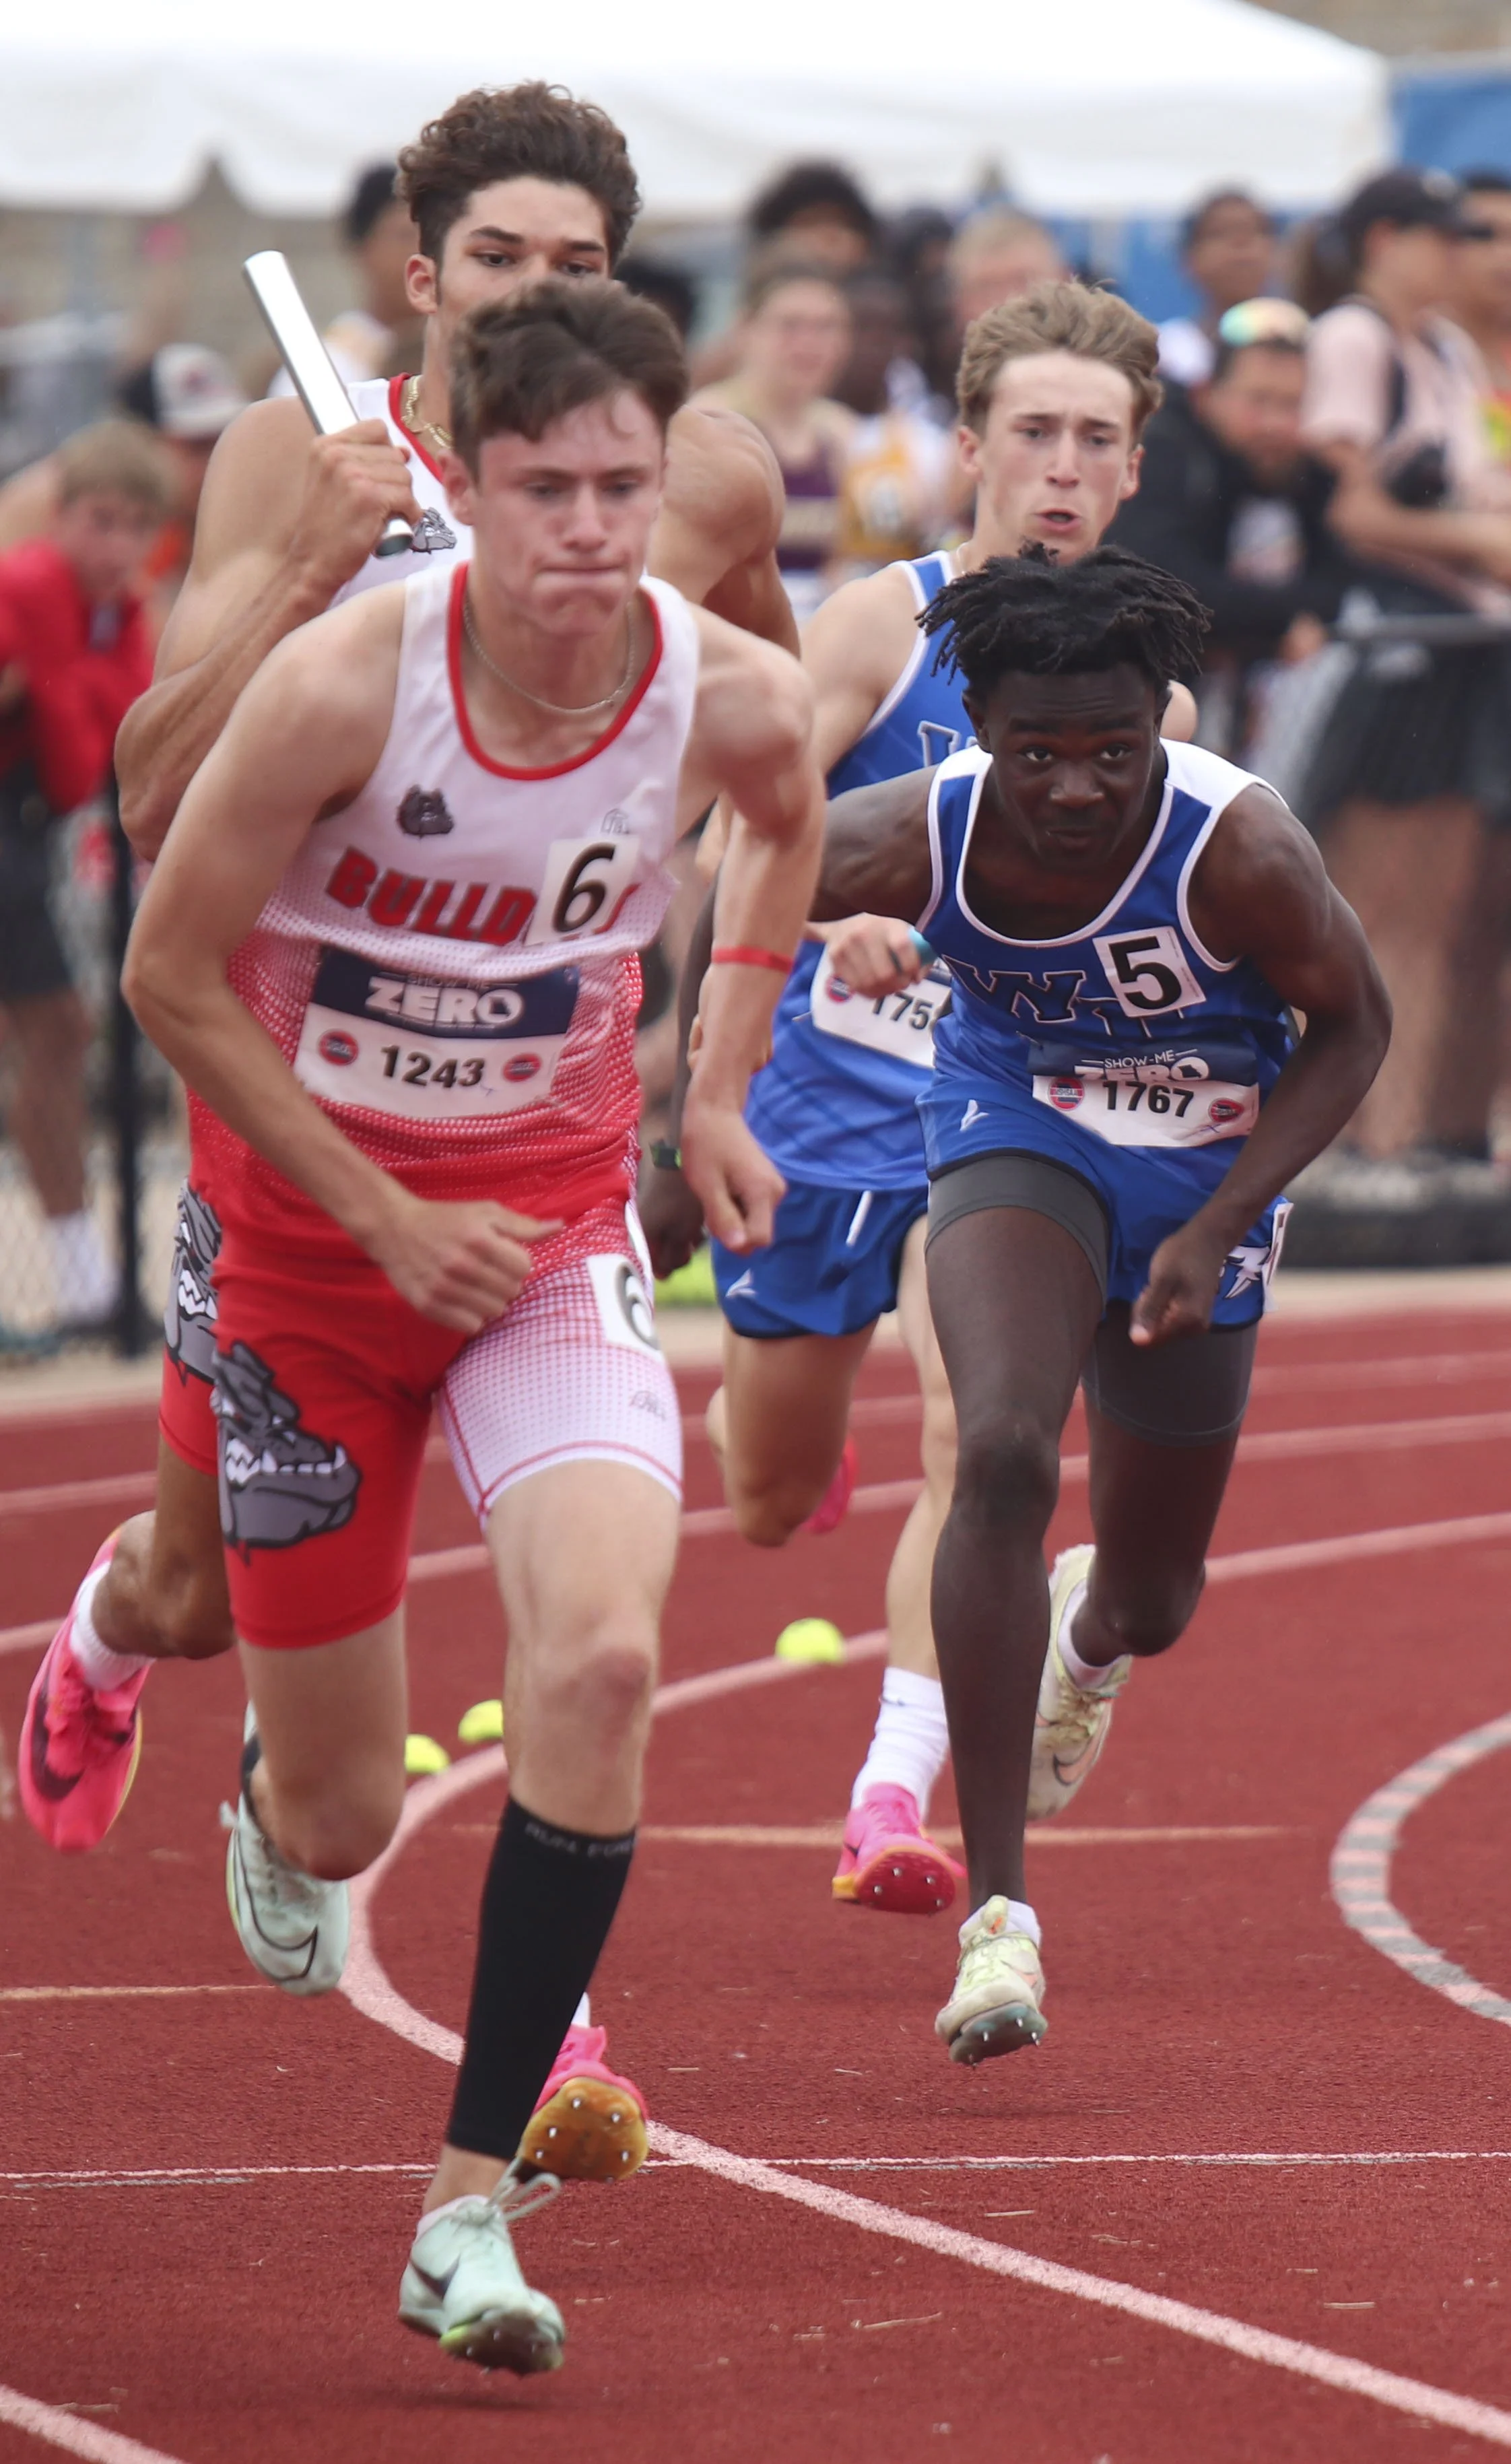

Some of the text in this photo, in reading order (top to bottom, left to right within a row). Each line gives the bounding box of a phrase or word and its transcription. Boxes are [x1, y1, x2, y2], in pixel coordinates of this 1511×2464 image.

[326, 844, 642, 946] BULLD
[552, 842, 616, 933] 6
[1108, 935, 1182, 1010] 5
[365, 976, 523, 1024] ZERO
[872, 990, 934, 1030] 175
[380, 1044, 485, 1088] 1243
[1102, 1080, 1195, 1118] 1767
